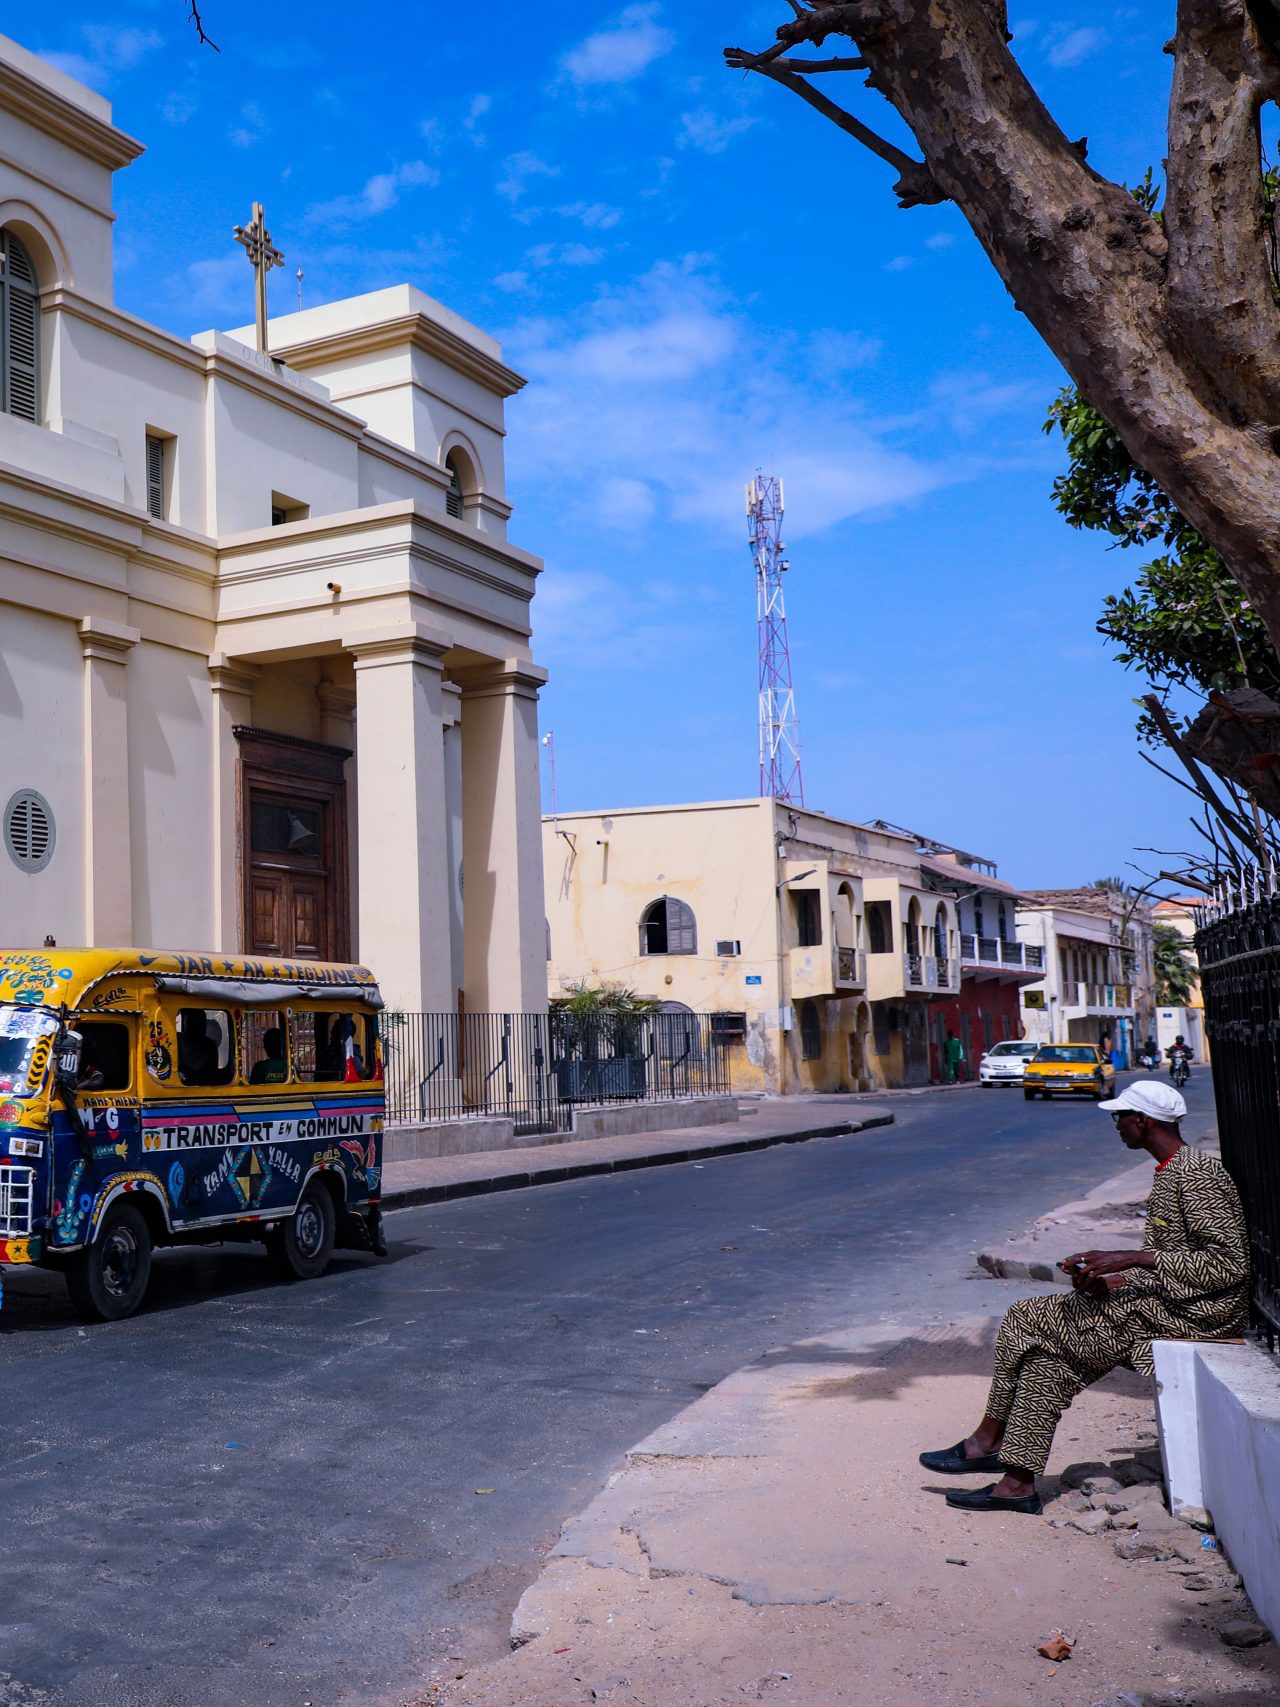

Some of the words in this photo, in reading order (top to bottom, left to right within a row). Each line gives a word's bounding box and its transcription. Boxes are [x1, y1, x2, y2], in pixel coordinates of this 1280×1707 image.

[163, 1121, 274, 1148] TRANSPORT
[278, 1122, 292, 1136] EN
[297, 1115, 364, 1138] COMMUN
